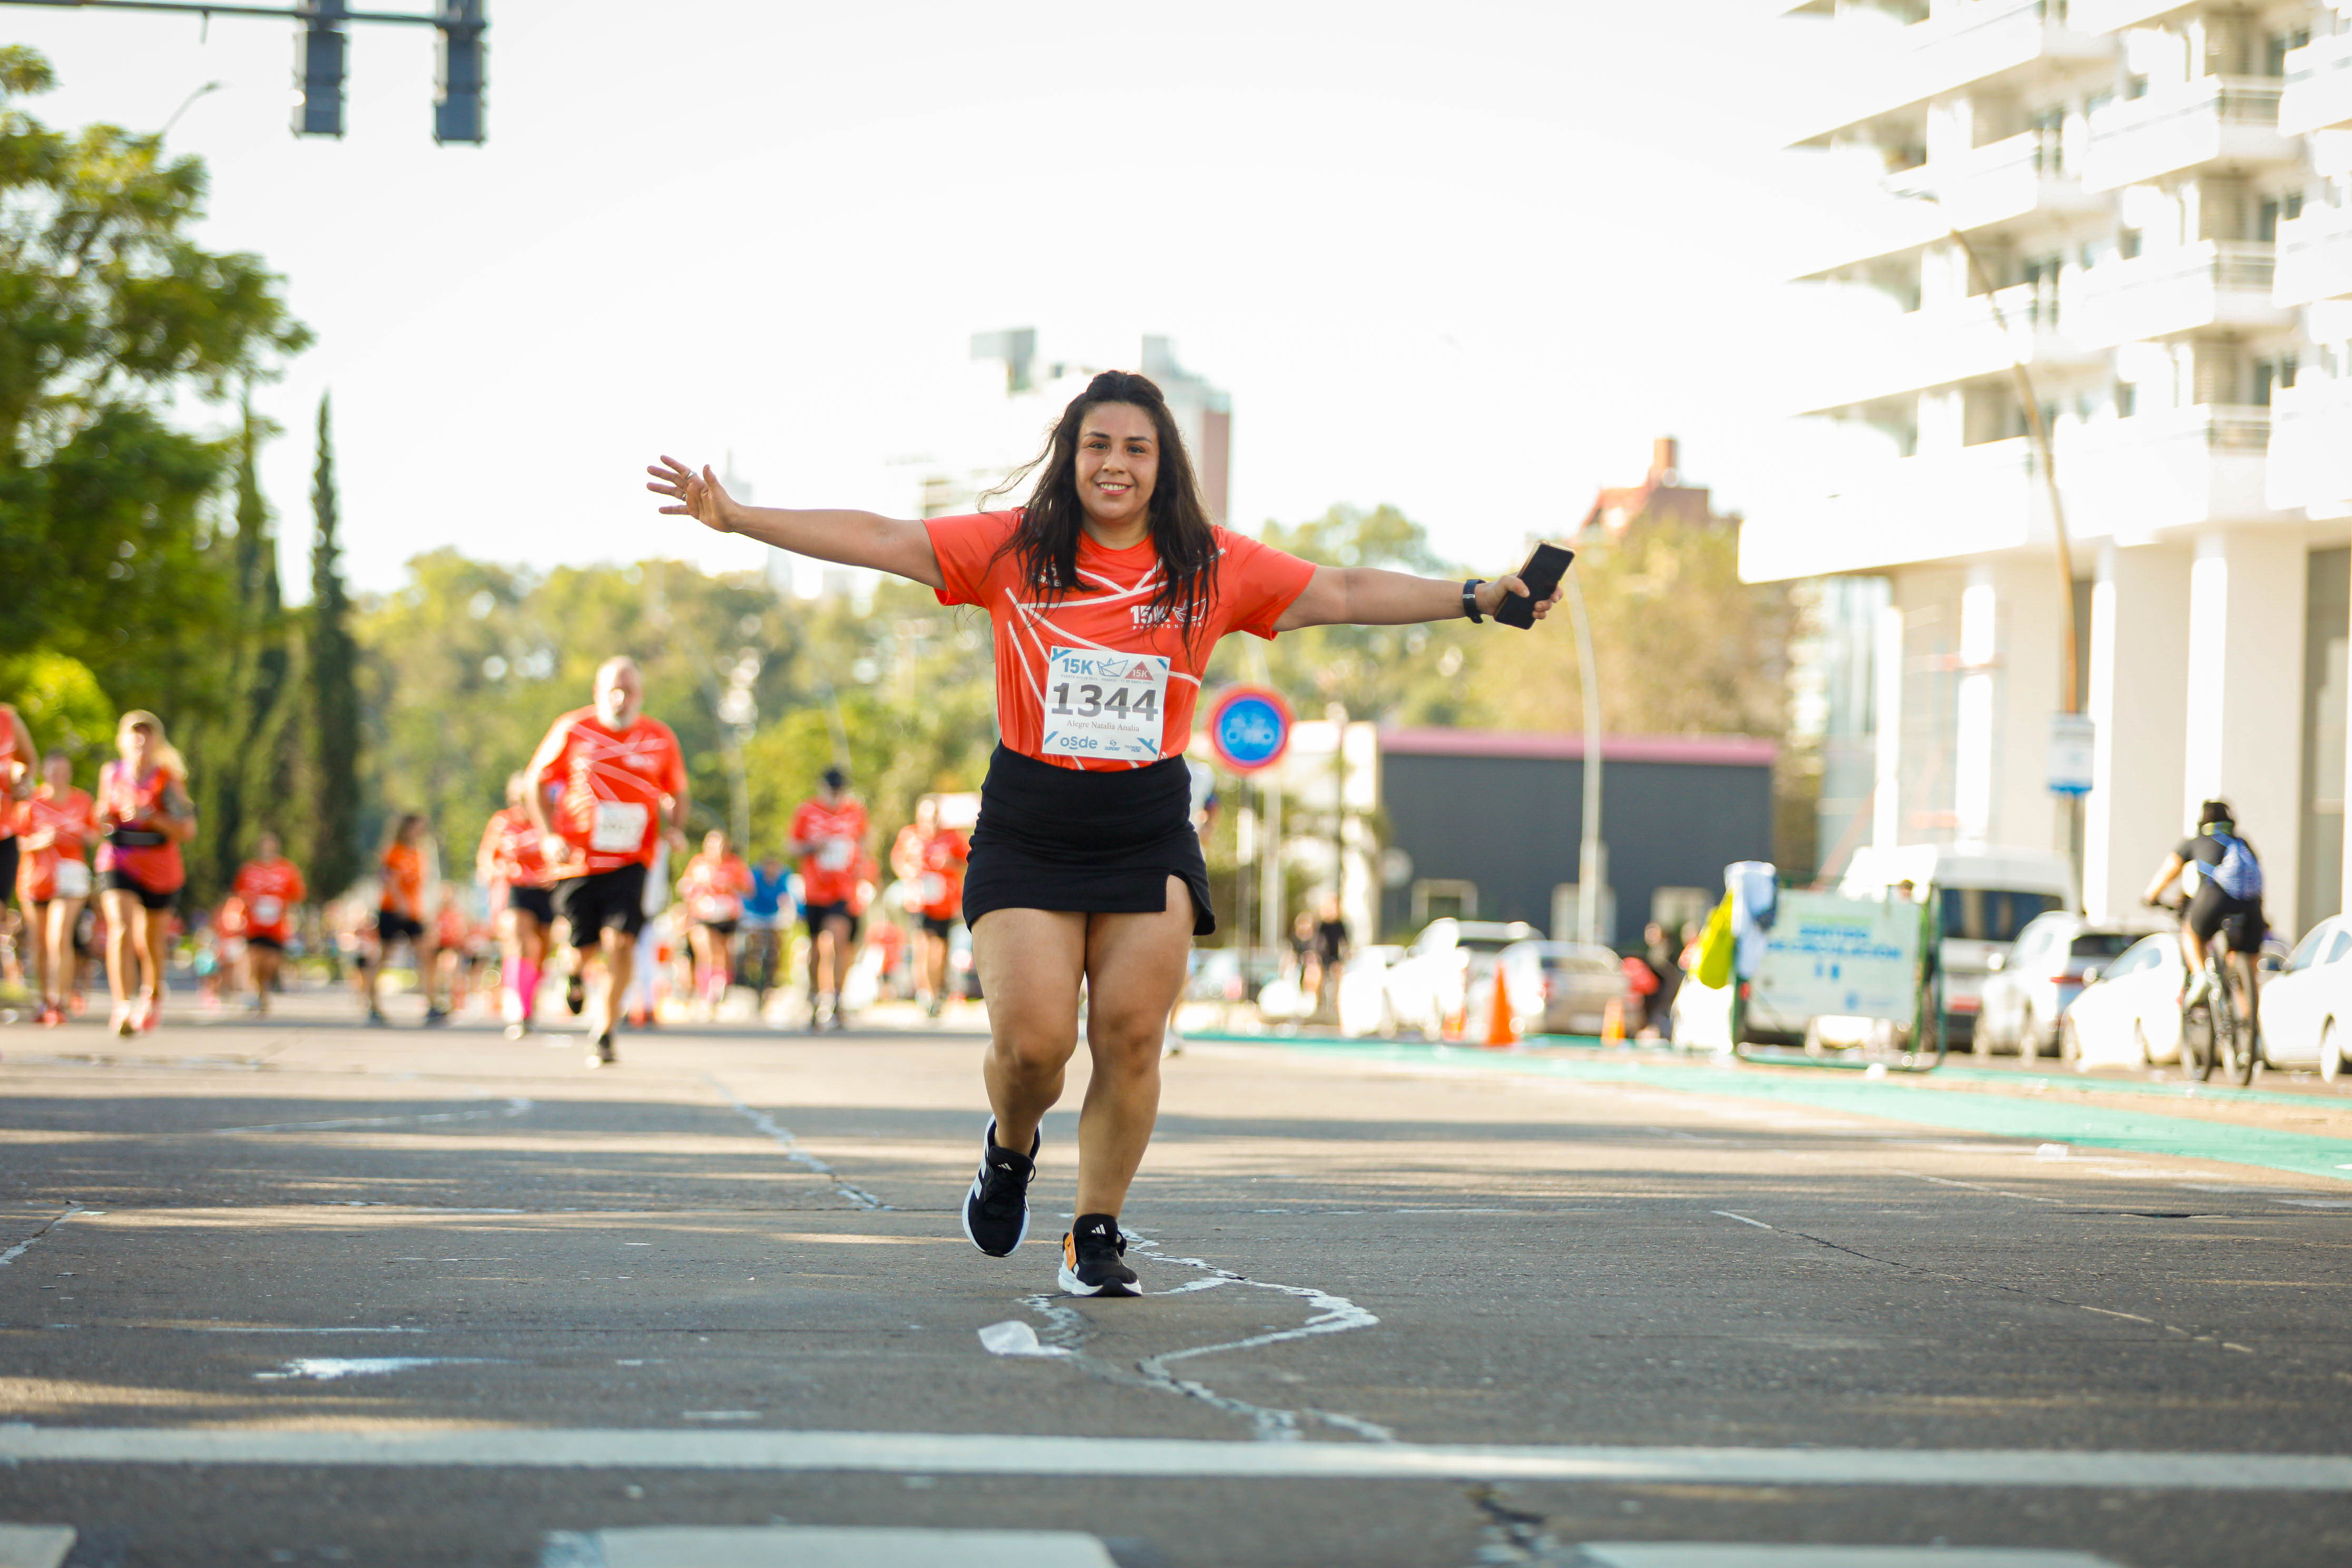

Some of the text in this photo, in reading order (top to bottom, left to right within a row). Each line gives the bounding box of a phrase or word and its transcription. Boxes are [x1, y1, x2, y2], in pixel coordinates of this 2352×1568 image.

[1130, 605, 1171, 624] 15K
[1063, 658, 1093, 675] 15K
[1132, 669, 1148, 678] 15K
[1052, 682, 1159, 722] 1344
[1066, 720, 1090, 729] Alegre
[1060, 736, 1098, 749] osde
